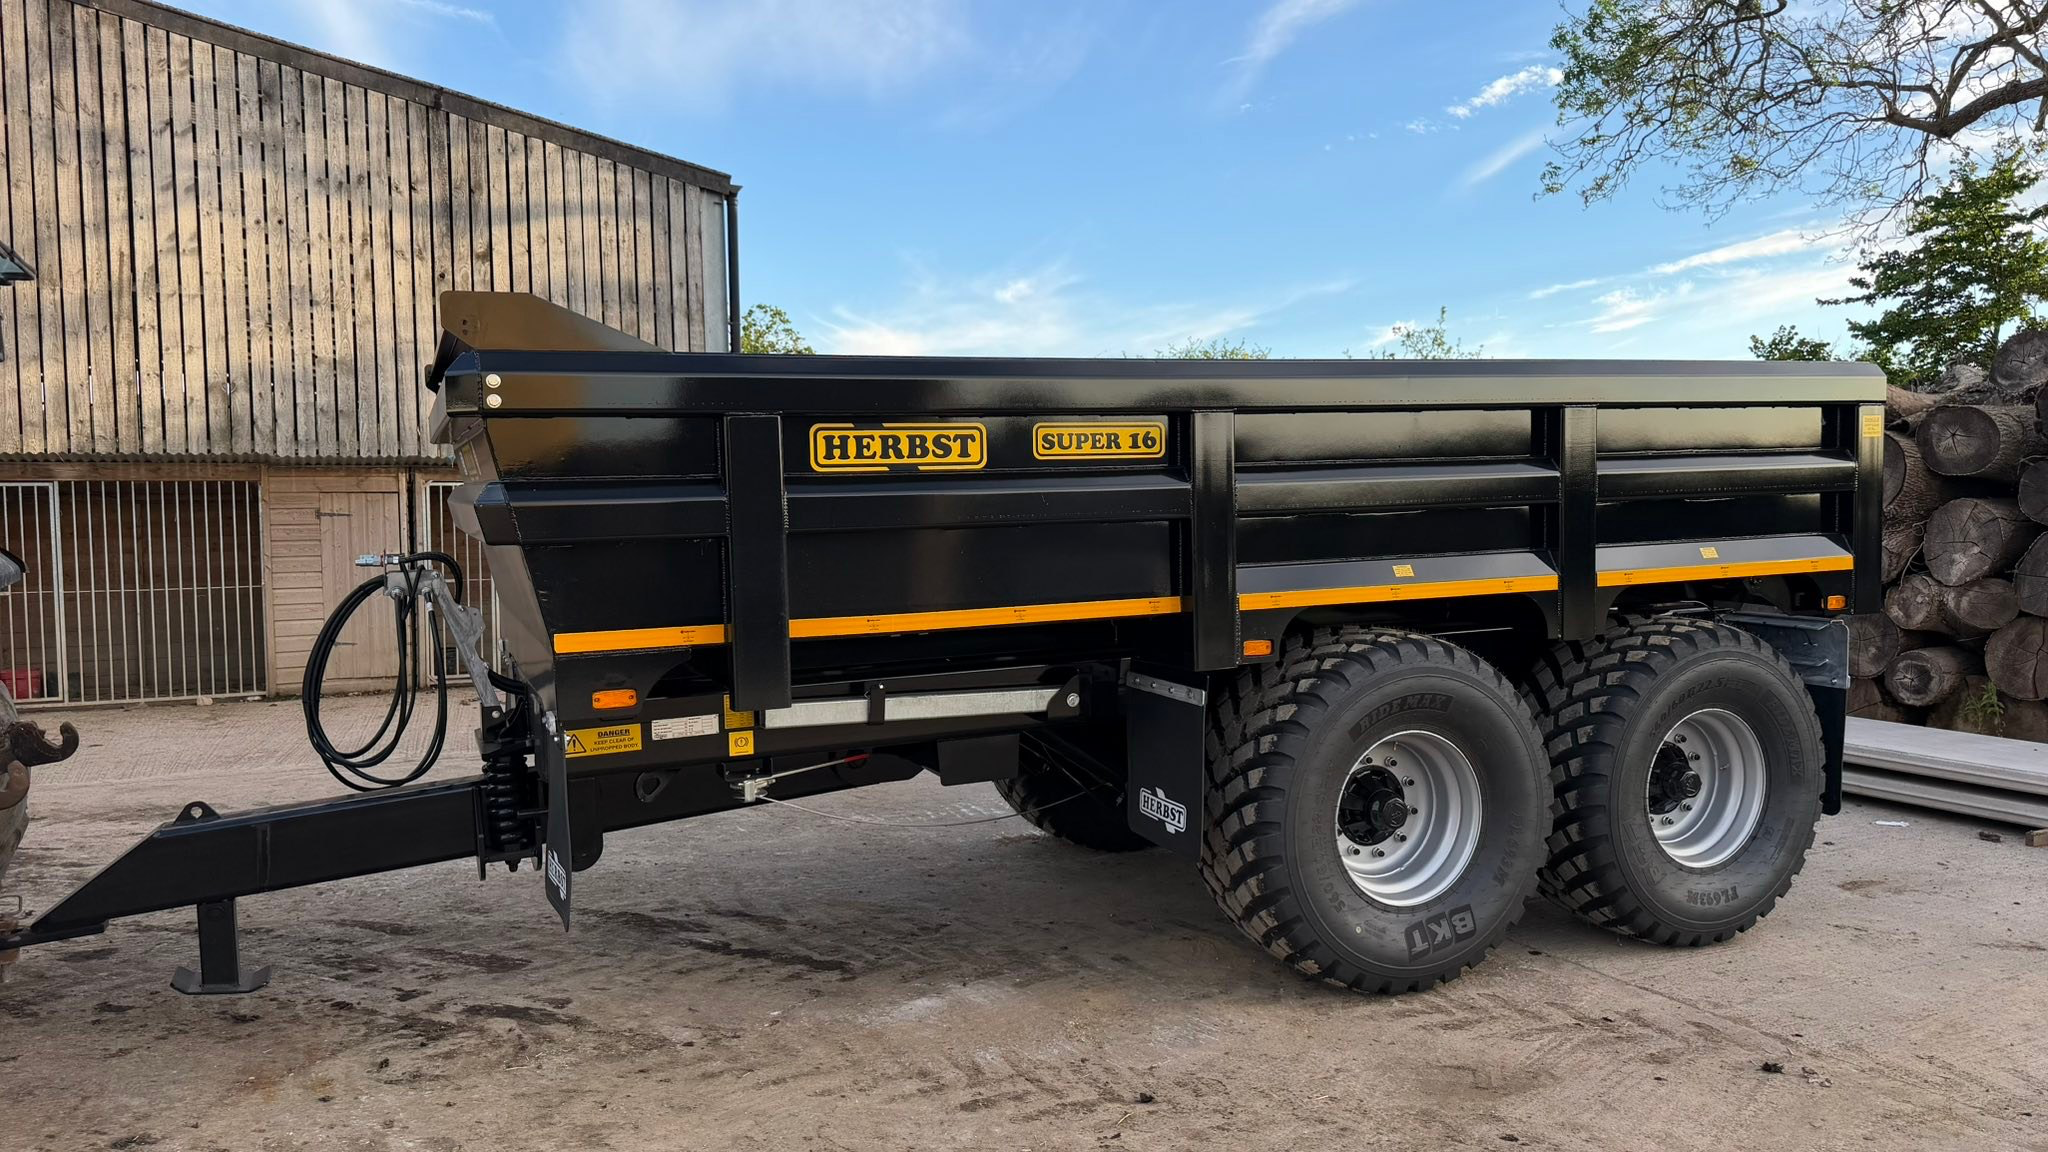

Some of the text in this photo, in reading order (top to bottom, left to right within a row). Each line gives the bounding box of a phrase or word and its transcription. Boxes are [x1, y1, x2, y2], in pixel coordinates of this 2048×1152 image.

[822, 433, 976, 460] HERBST
[1041, 433, 1157, 451] SUPER 16
[598, 729, 630, 737] DANGER
[1143, 794, 1184, 825] HERBST
[1410, 910, 1475, 956] BKT
